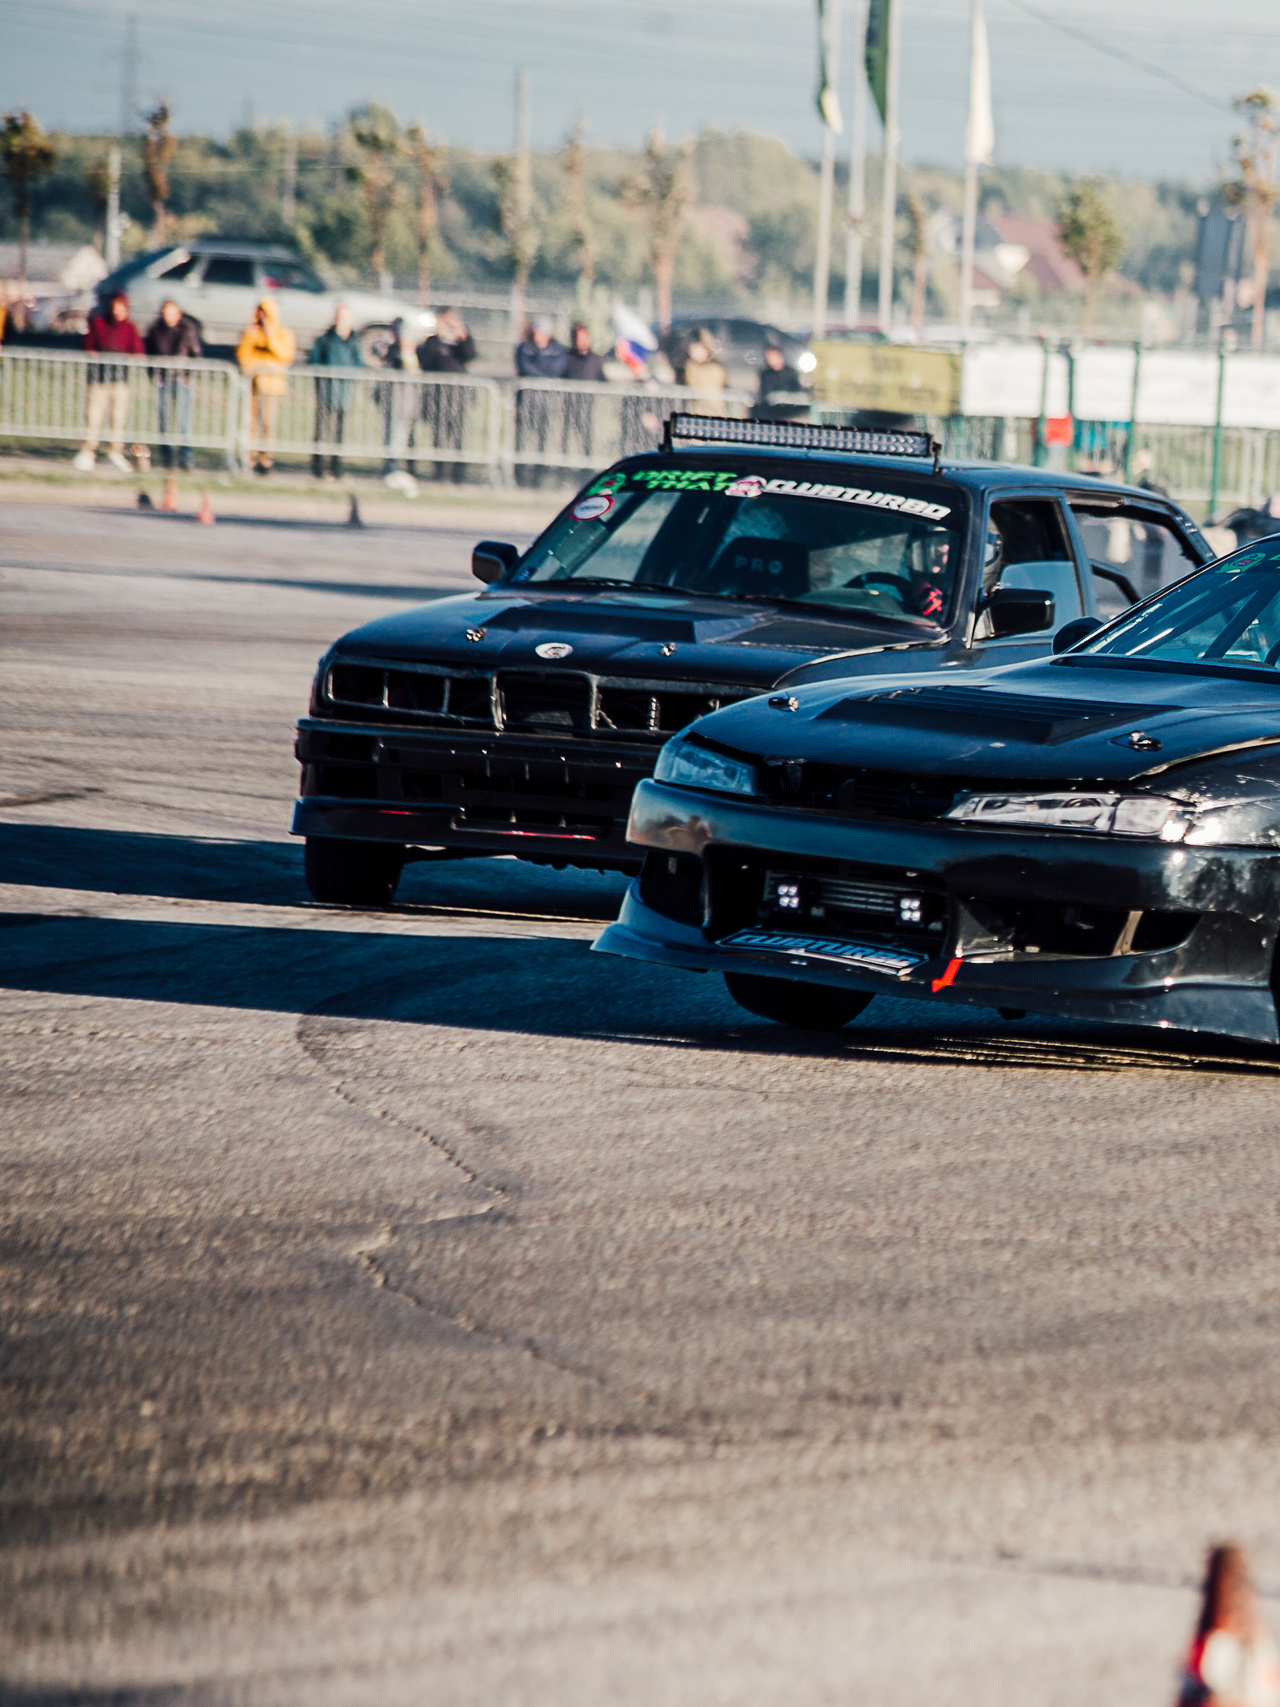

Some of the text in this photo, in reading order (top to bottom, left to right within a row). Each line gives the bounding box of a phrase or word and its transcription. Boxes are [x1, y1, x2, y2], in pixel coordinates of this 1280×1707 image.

[632, 470, 738, 481] DRIFT
[764, 479, 951, 519] CLUBTURBO
[734, 555, 783, 574] PRO
[728, 934, 920, 968] CLUBTURBO
